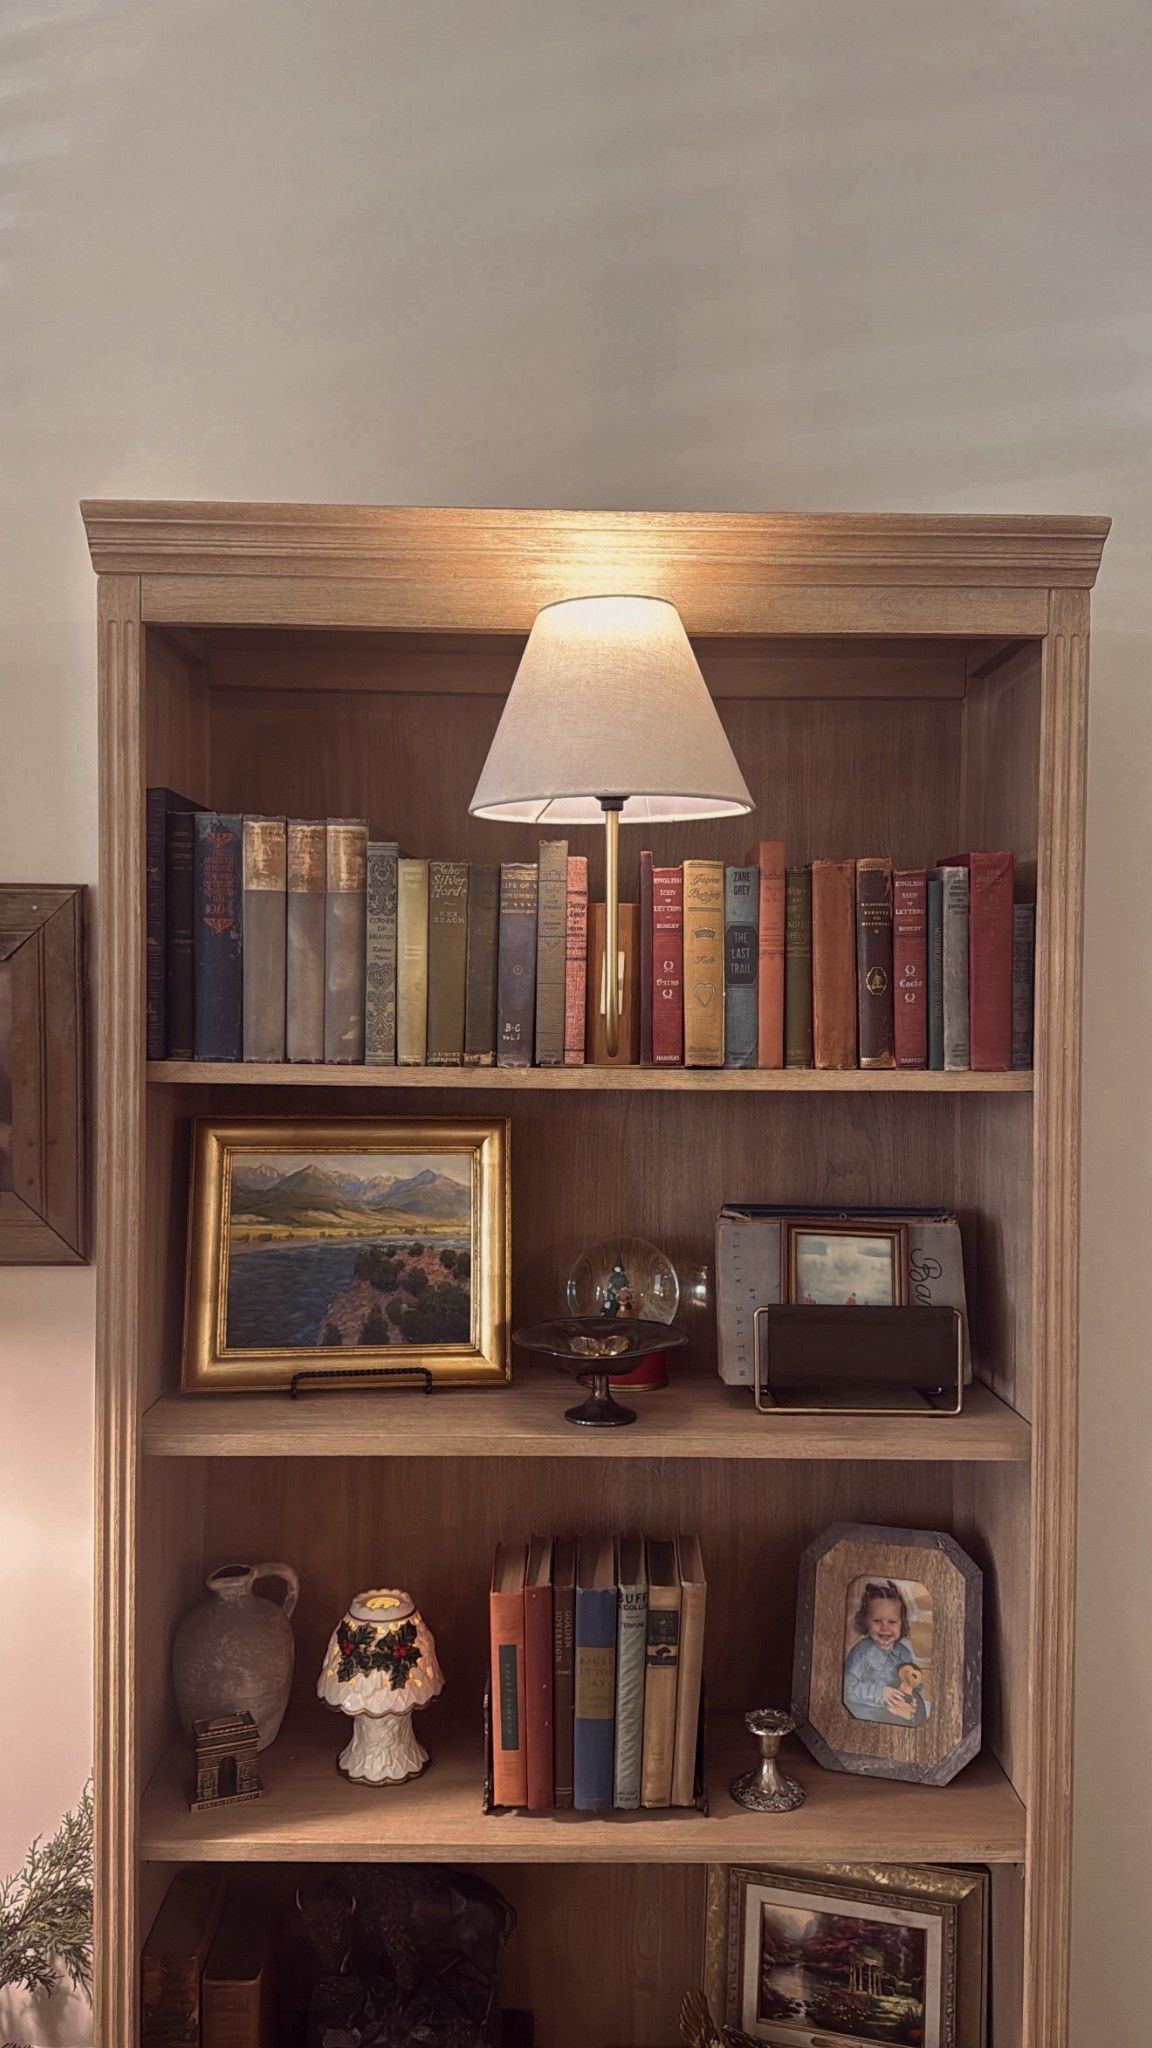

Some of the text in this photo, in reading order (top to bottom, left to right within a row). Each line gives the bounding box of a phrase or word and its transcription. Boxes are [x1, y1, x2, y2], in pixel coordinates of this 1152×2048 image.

[433, 864, 466, 875] The
[431, 875, 468, 886] Silver
[733, 871, 751, 882] ZANE
[430, 885, 467, 898] Horde
[733, 884, 751, 896] GREY
[734, 932, 748, 943] THE
[731, 947, 751, 959] LAST
[730, 963, 751, 974] TRAIL
[749, 1287, 756, 1300] BY
[732, 1231, 747, 1377] FELIX SALTEN
[564, 1610, 573, 1648] GOLDEN
